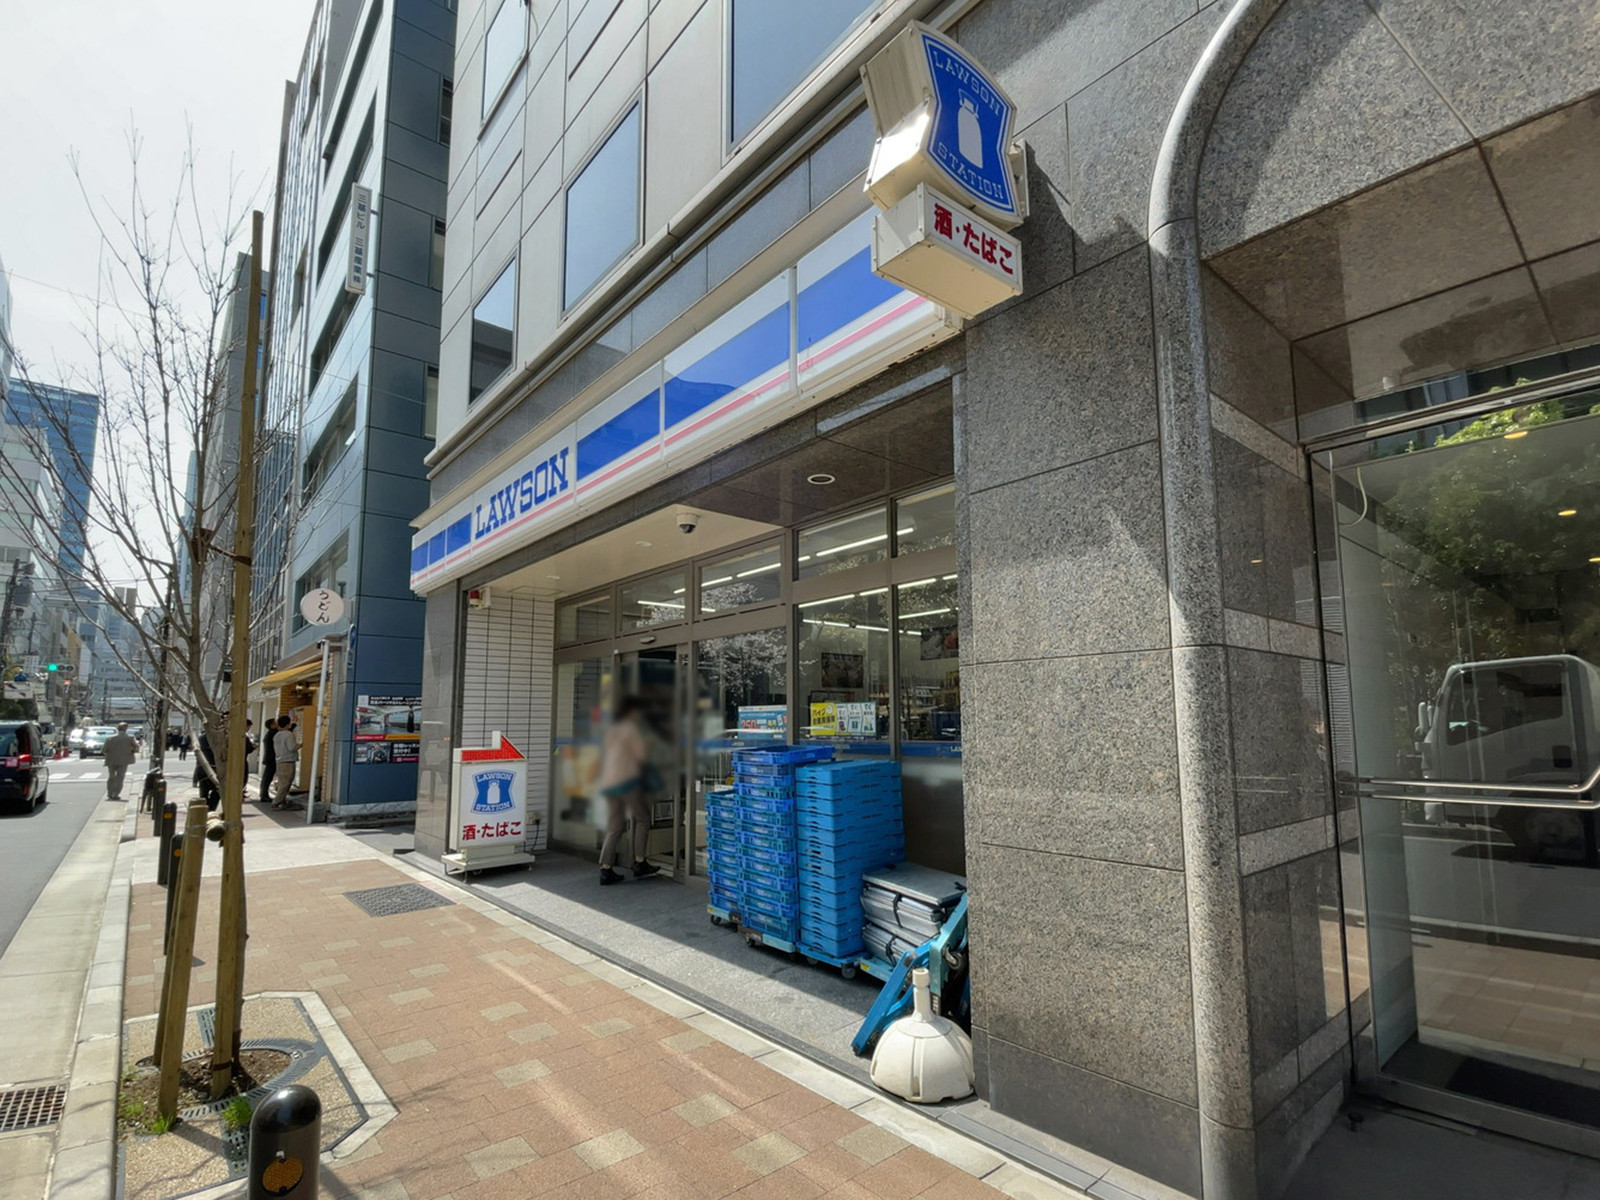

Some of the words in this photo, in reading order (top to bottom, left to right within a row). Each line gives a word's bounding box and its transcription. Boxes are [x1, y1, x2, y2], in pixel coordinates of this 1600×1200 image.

[932, 49, 1001, 118] LAWSON
[937, 140, 1004, 200] STATION
[933, 202, 1014, 275] 酒・たばこ
[475, 446, 569, 540] LAWSON
[316, 590, 330, 624] うどん
[476, 772, 512, 783] LAWSON
[462, 821, 522, 840] 酒・たばこ
[475, 802, 511, 813] STATION
